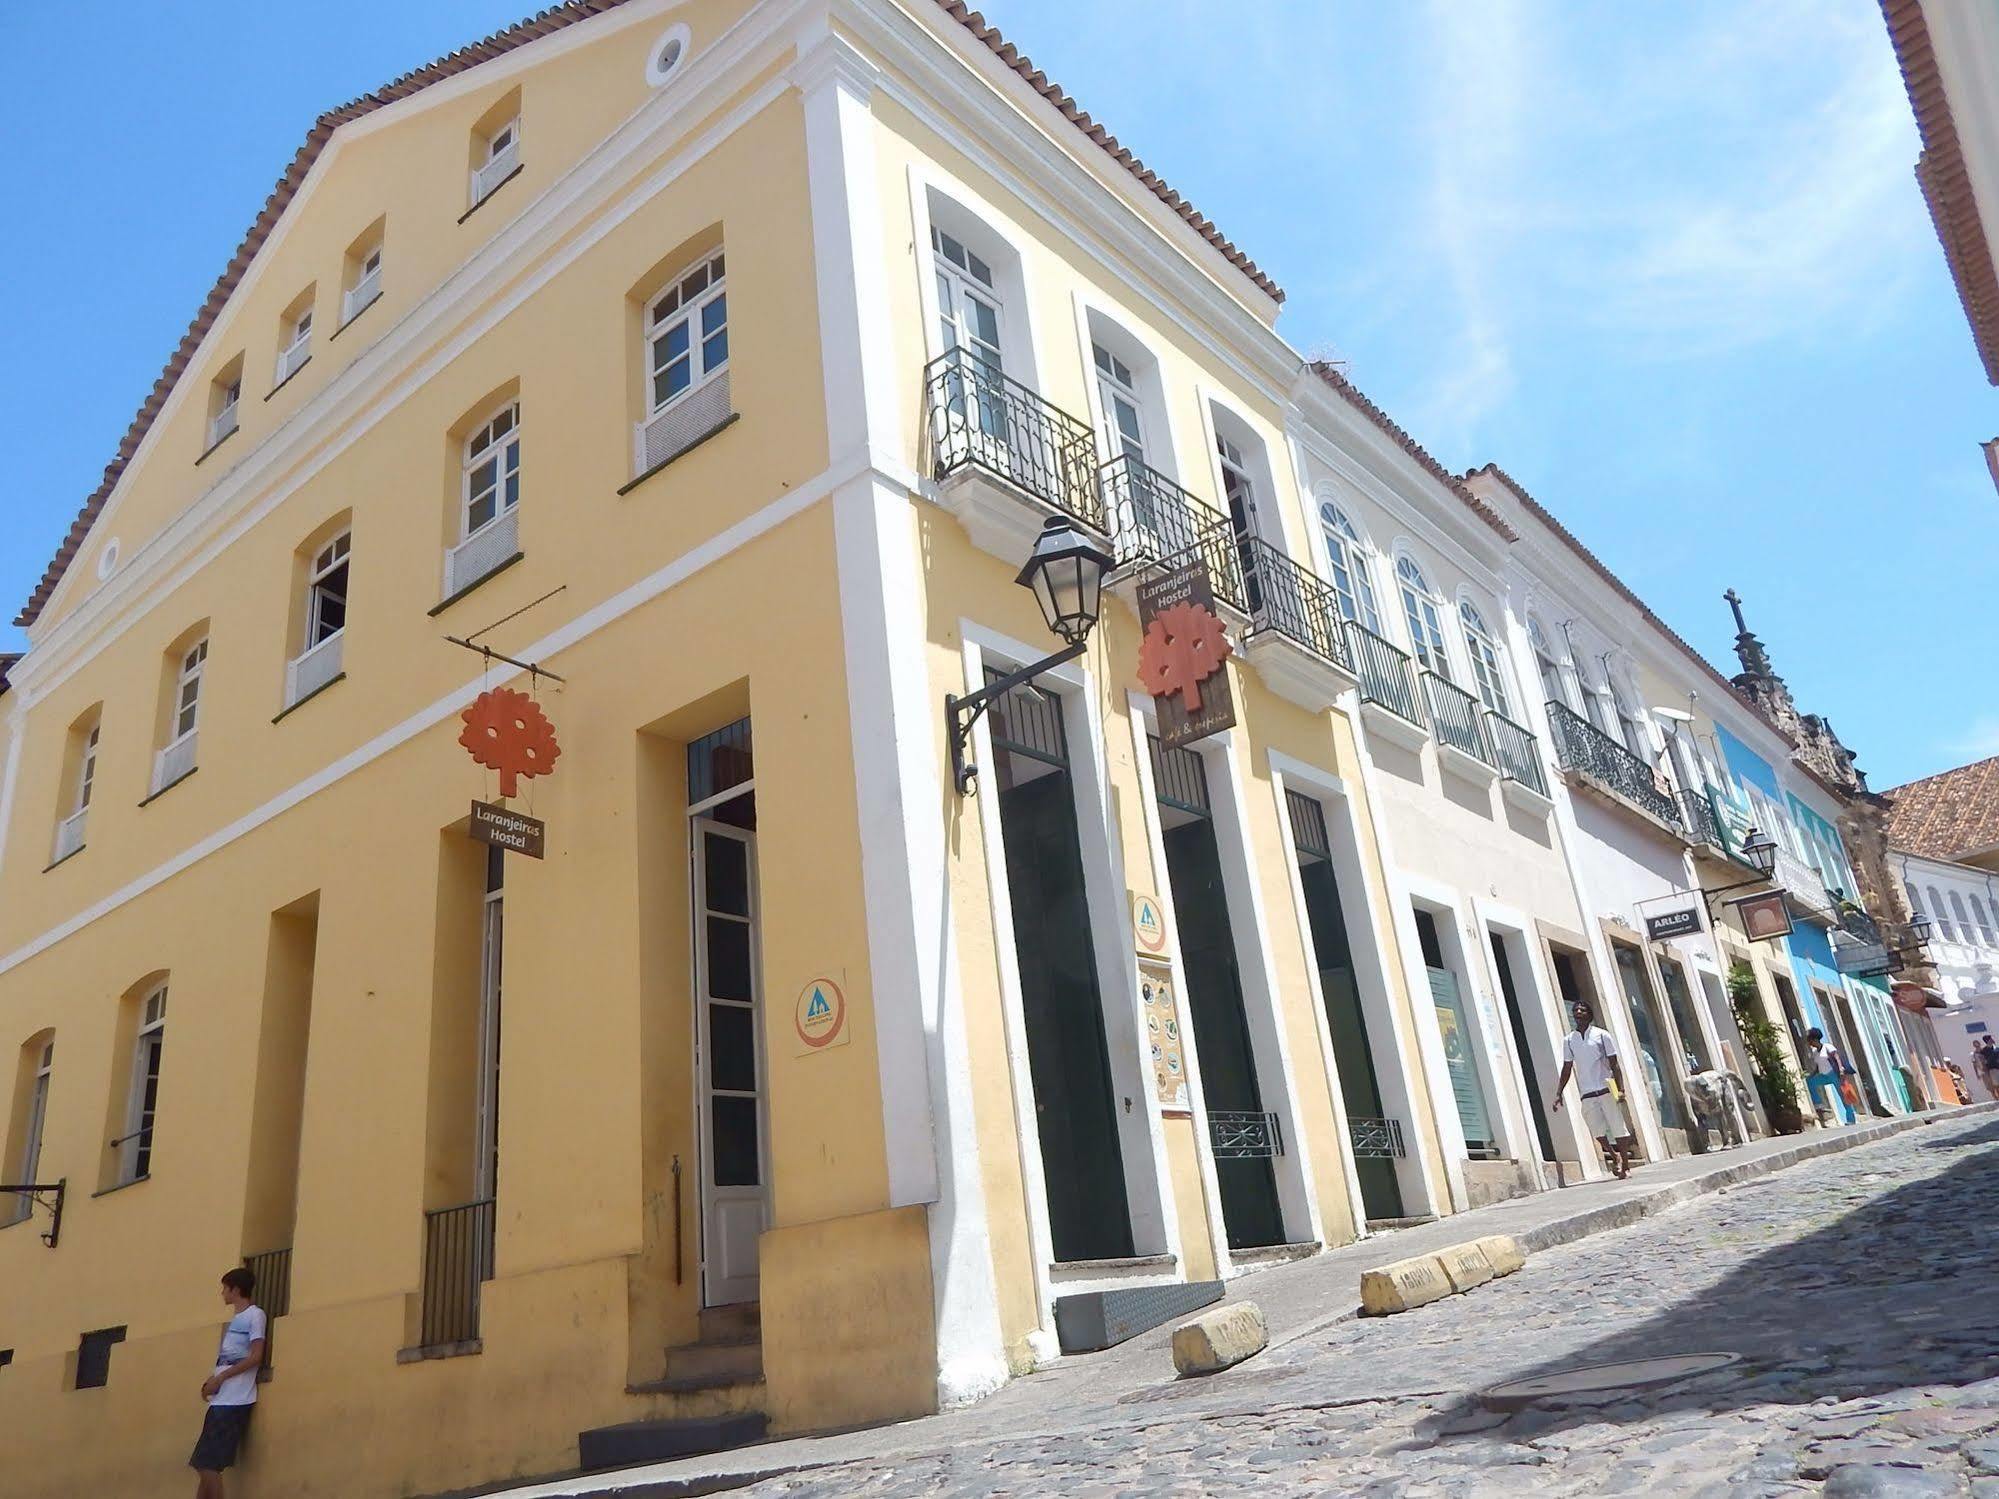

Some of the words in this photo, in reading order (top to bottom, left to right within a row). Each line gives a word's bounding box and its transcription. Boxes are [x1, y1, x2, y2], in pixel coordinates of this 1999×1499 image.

[1142, 566, 1203, 599] Laranjeiras
[1158, 584, 1192, 608] Hostel
[477, 806, 540, 837] Laranjeiras
[491, 829, 526, 848] Hostel
